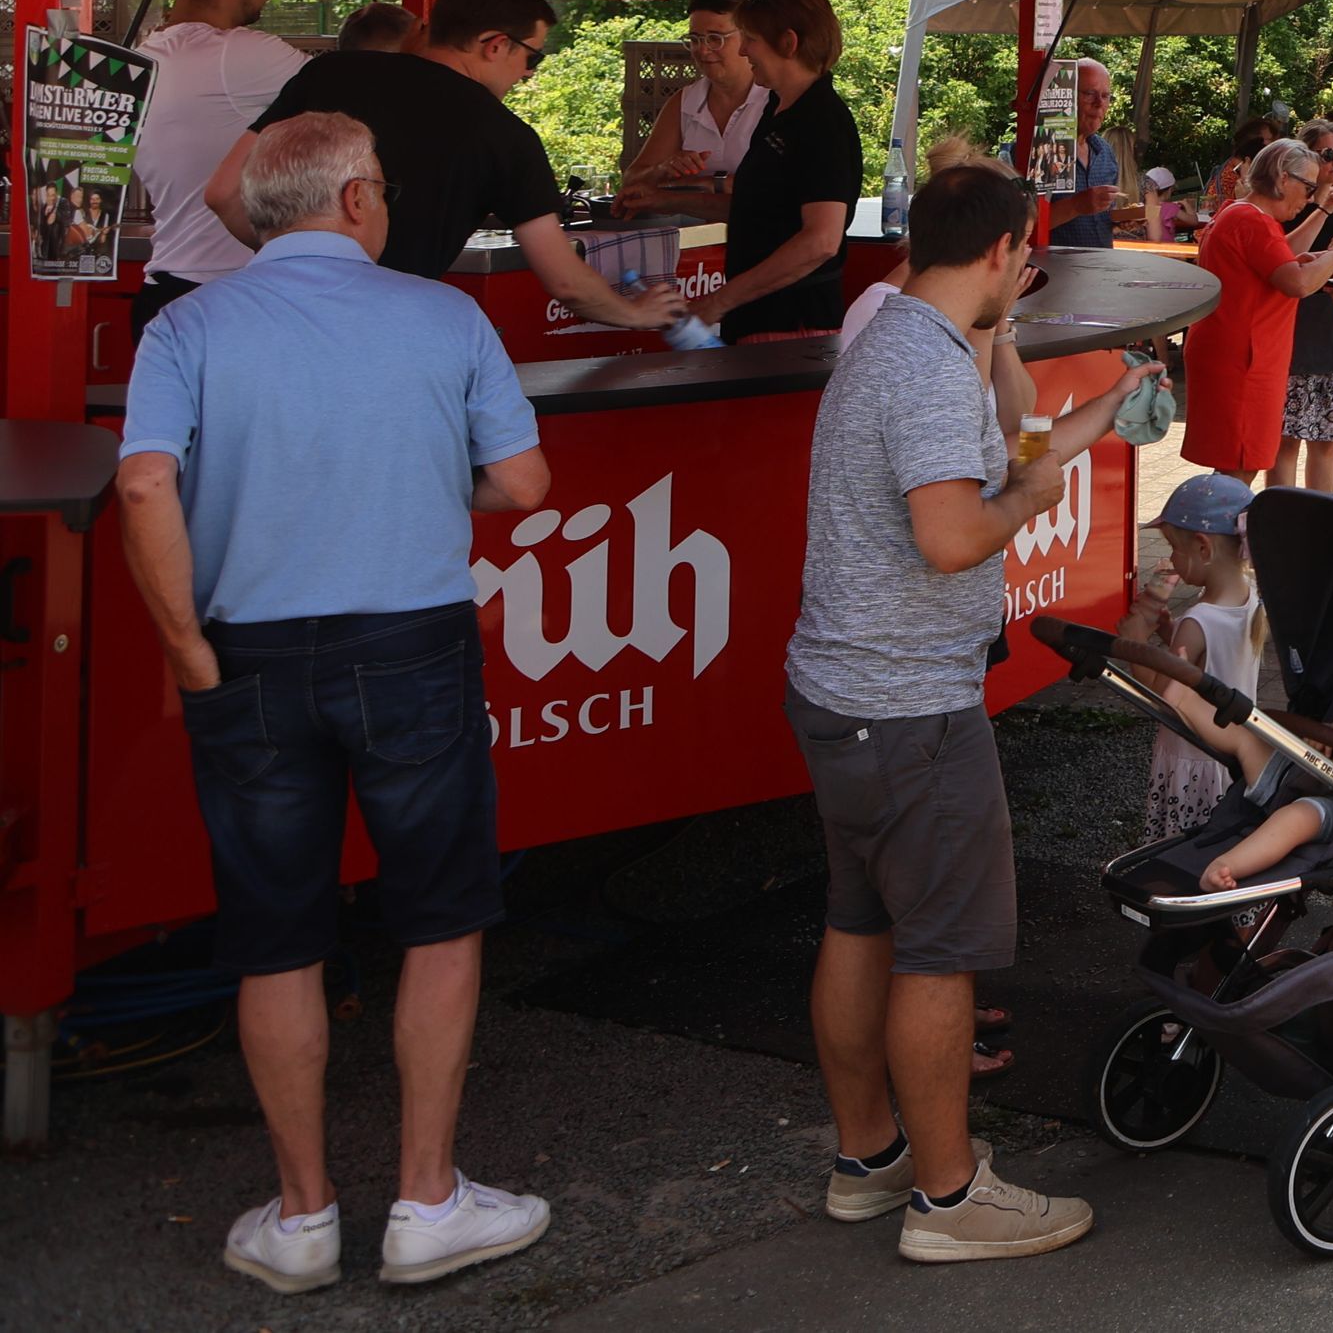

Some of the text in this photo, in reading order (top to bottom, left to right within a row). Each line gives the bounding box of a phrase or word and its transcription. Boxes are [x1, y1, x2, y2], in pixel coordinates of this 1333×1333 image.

[54, 106, 82, 123] LIVE
[83, 110, 131, 128] 2026
[1304, 751, 1321, 767] ABC
